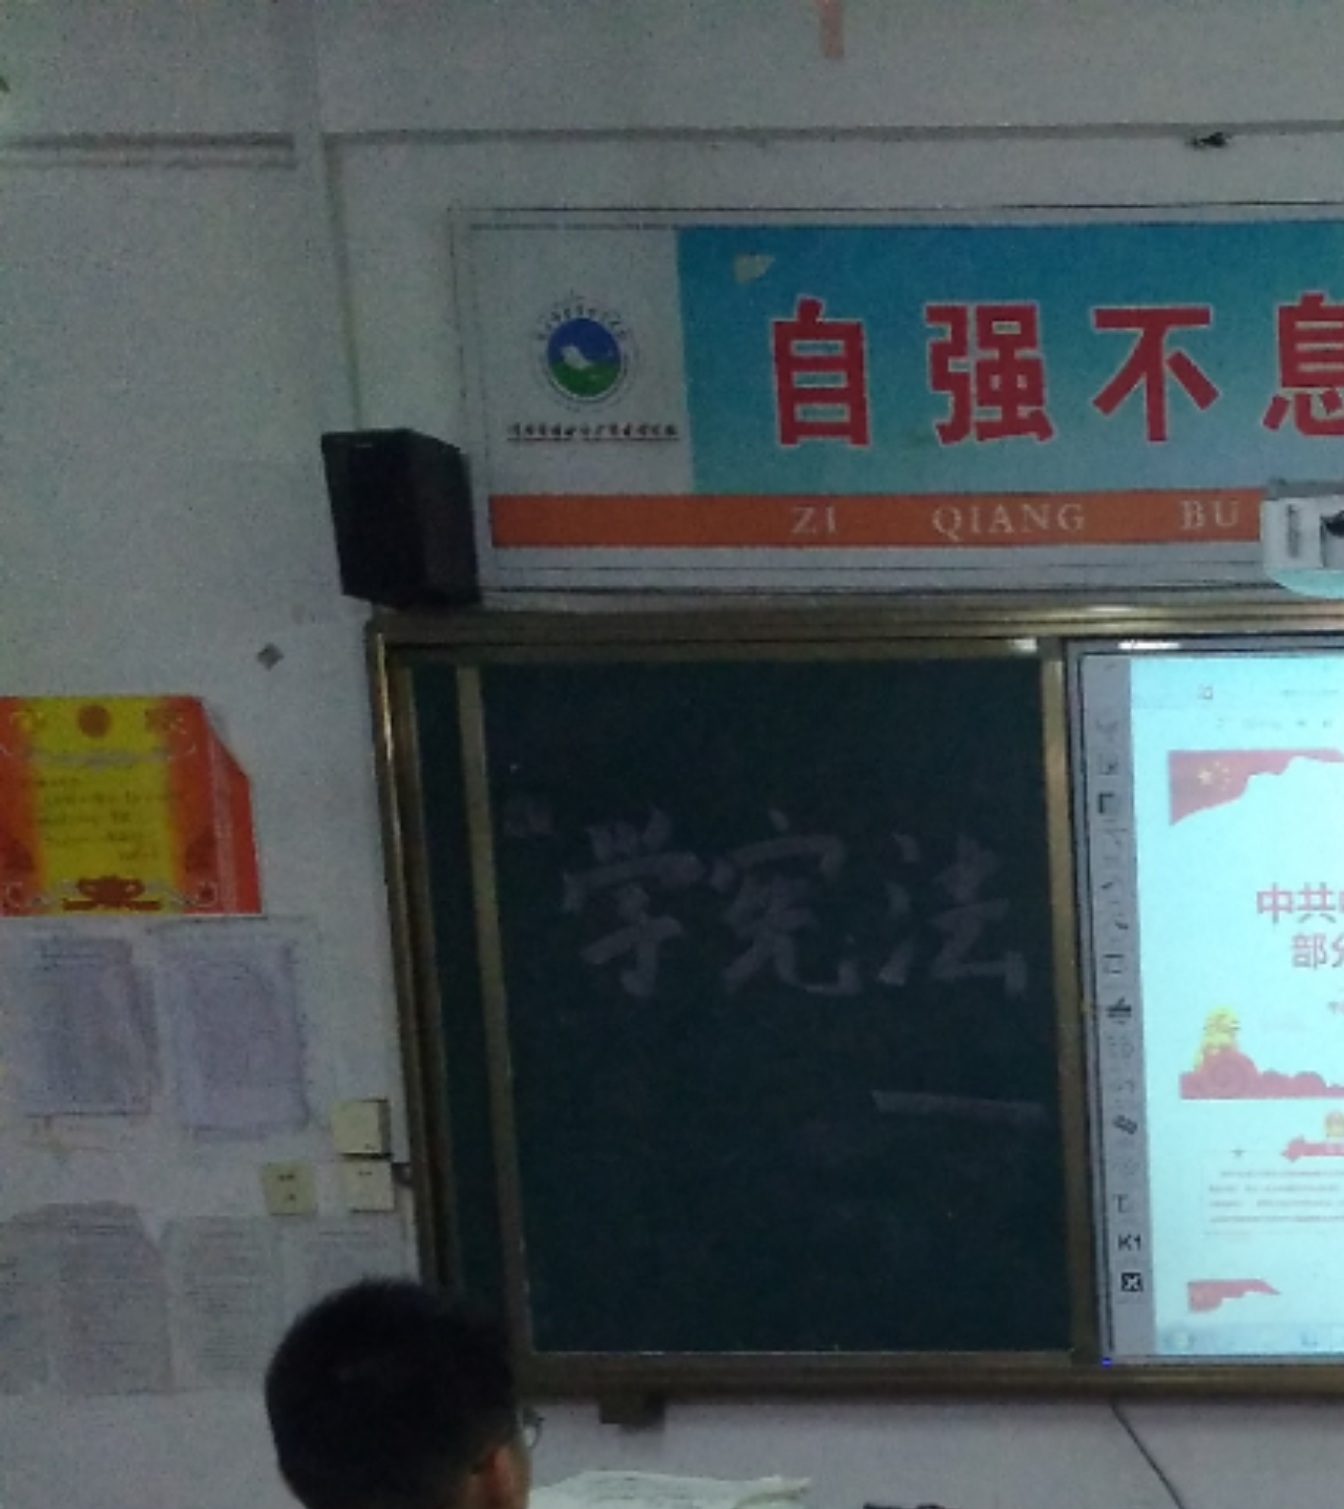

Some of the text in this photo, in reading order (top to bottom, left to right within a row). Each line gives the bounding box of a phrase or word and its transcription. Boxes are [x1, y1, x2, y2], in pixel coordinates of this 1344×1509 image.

[791, 500, 1240, 541] ZI QIANG BU
